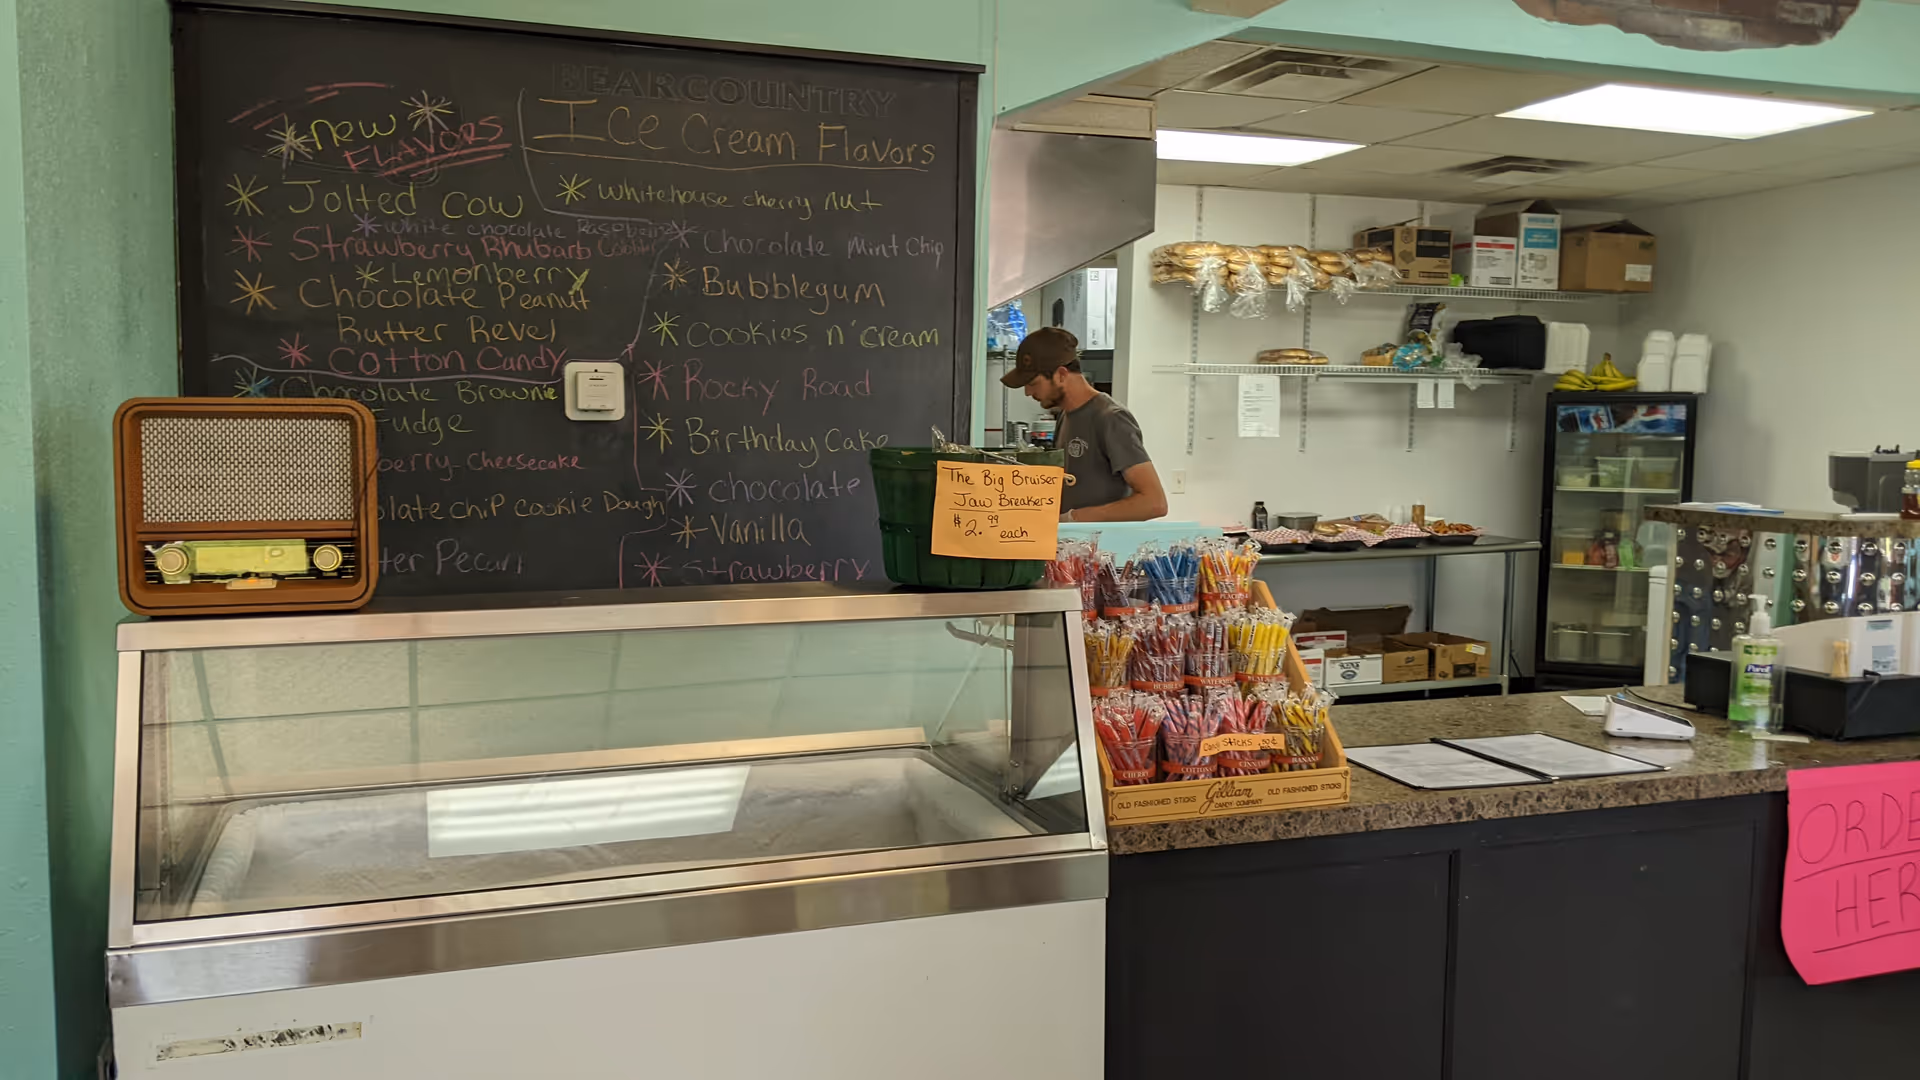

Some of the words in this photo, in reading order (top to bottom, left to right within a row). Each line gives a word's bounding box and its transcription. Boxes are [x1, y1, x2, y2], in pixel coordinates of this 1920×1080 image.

[681, 113, 796, 161] Cream
[818, 122, 936, 165] Flavors
[283, 180, 417, 215] Jolted
[742, 190, 811, 219] cherry
[824, 188, 883, 211] nut
[288, 223, 477, 267] Strawberry
[480, 236, 591, 261] Rhubarb
[848, 232, 898, 259] Mint
[299, 275, 484, 309] Chocolate
[500, 281, 591, 310] Peanut
[392, 262, 591, 294] Lemonberry
[702, 265, 886, 315] Bubblegum
[337, 314, 448, 344] Butter
[469, 317, 557, 343] Revel
[687, 320, 807, 347] Cookies
[328, 346, 464, 376] Cotton
[476, 346, 567, 377] Candy
[279, 375, 431, 402] Chocolate
[455, 380, 559, 404] Brownie
[684, 358, 780, 416] Rocky
[802, 367, 873, 400] Road
[685, 417, 820, 468] Birthday
[825, 428, 889, 452] Cake
[941, 466, 975, 485] The
[982, 469, 1004, 493] Big
[1012, 470, 1058, 486] Bruiser
[603, 490, 666, 519] Dough
[953, 492, 993, 508] Jaw
[999, 493, 1054, 507] Breakers
[710, 513, 811, 546] Vanilla
[1000, 526, 1029, 539] each
[1117, 802, 1130, 810] OLD
[1134, 797, 1171, 808] FASHIONED
[1174, 795, 1197, 805] STICKS
[1199, 780, 1254, 814] Gilliam
[1214, 801, 1234, 809] CANDY
[1236, 798, 1264, 808] COMPANY
[1267, 787, 1281, 796] OLD
[1282, 784, 1318, 794] FASHIONED
[1321, 782, 1342, 791] STICKS
[1835, 861, 1920, 937] HER
